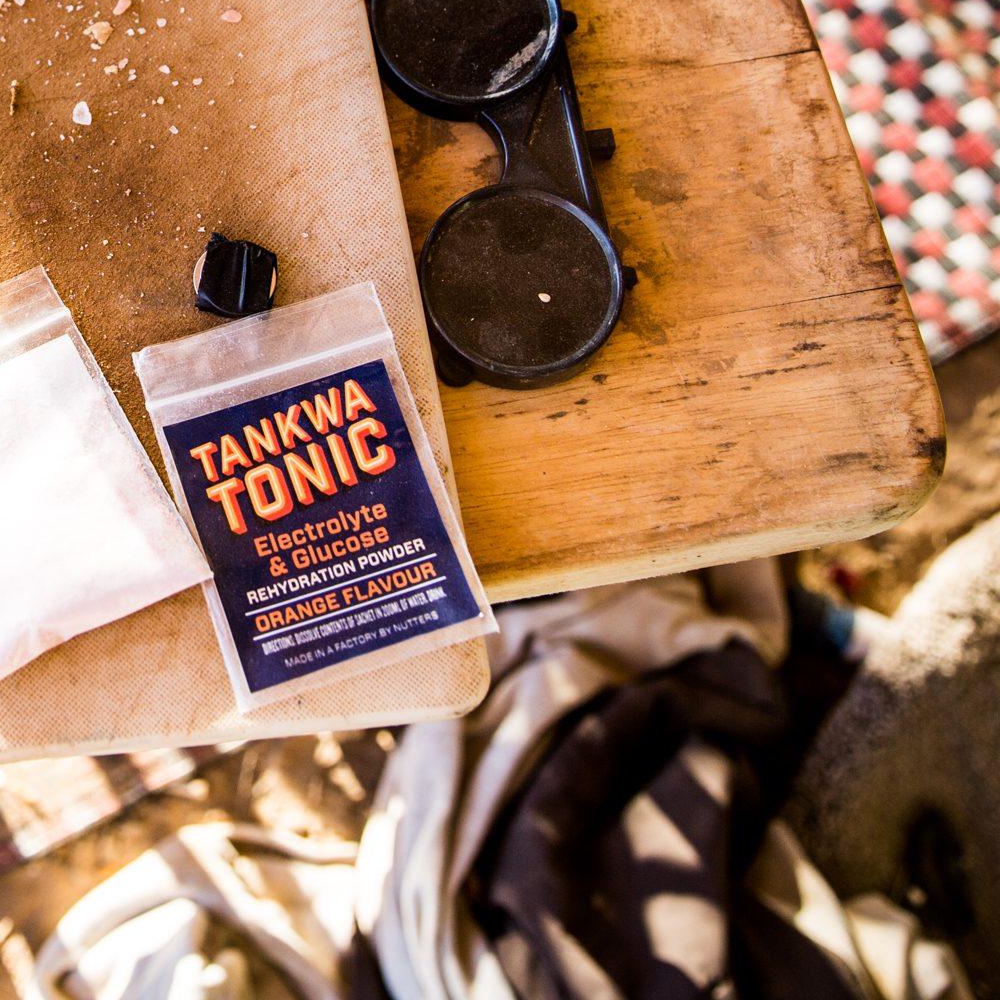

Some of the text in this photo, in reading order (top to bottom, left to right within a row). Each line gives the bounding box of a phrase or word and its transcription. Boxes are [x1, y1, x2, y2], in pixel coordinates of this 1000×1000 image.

[190, 379, 377, 482] TANKWA
[206, 417, 396, 535] TONIC
[253, 503, 388, 557] Electrolyte
[269, 526, 390, 577] & Glucose
[246, 537, 426, 604] REHYDRATION POWDER
[255, 561, 437, 632] ORANGE FLAVOUR
[284, 609, 439, 668] MADE IN A FACTORY BY NUTTERS
